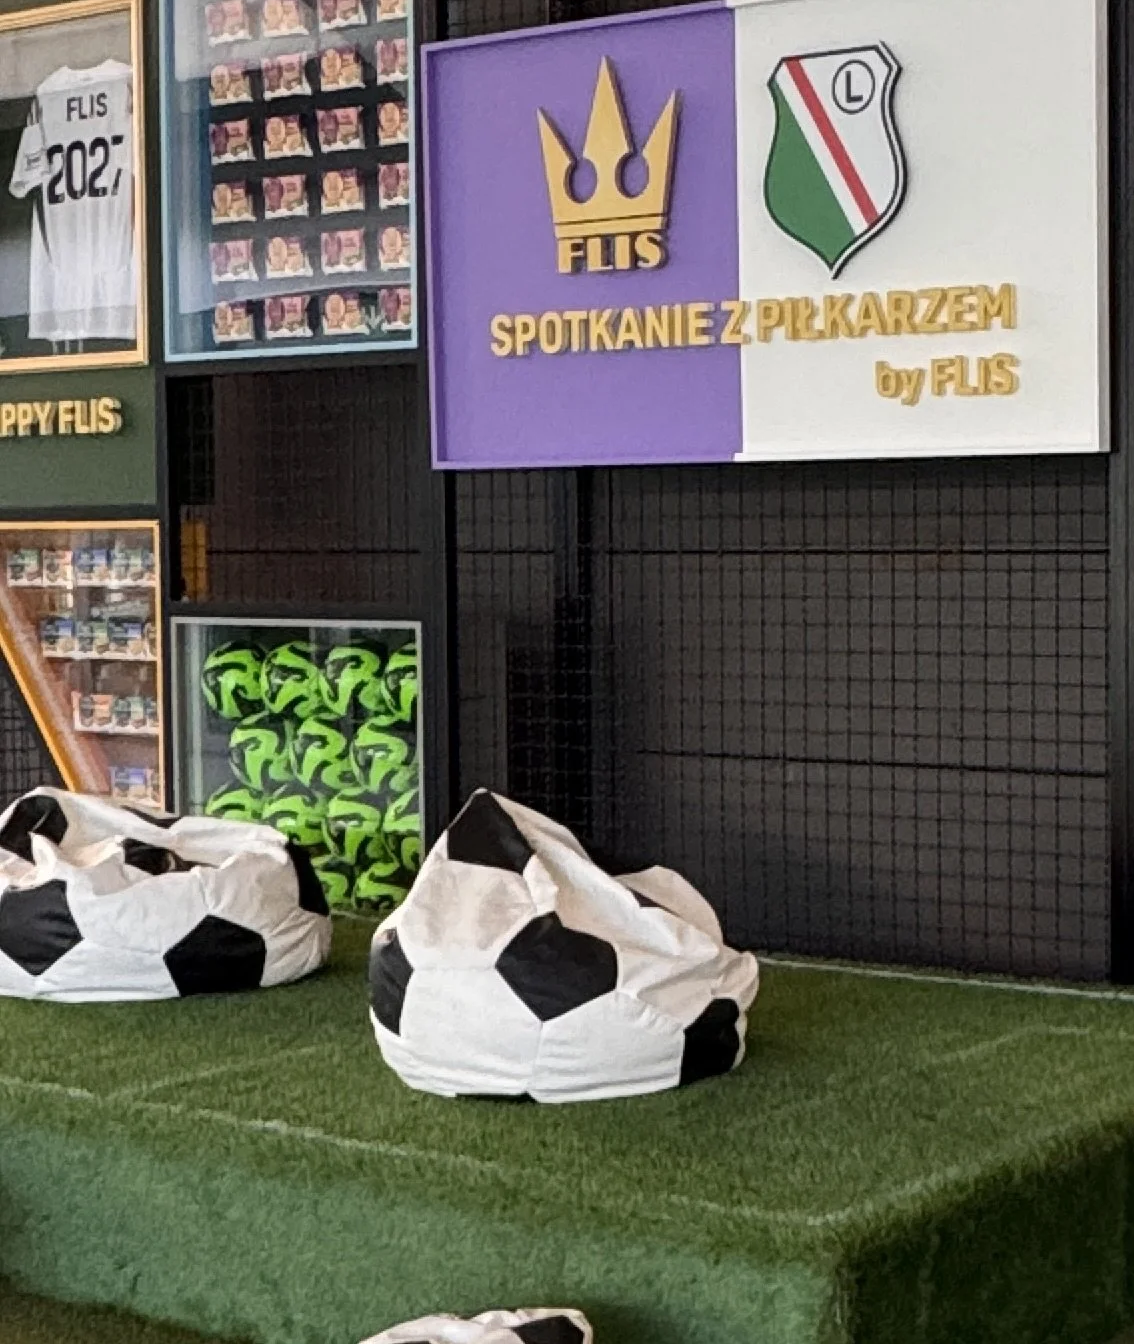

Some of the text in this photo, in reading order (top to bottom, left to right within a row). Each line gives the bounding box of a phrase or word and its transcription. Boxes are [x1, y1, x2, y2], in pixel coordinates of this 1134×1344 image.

[66, 92, 108, 122] FLIS
[845, 71, 864, 103] L
[46, 135, 124, 205] 2027
[557, 232, 668, 274] FLIS
[490, 283, 1017, 357] SPOTKANIE Z PIŁKARZEM
[875, 353, 1021, 407] by FLIS
[0, 396, 123, 436] PPY FLIS
